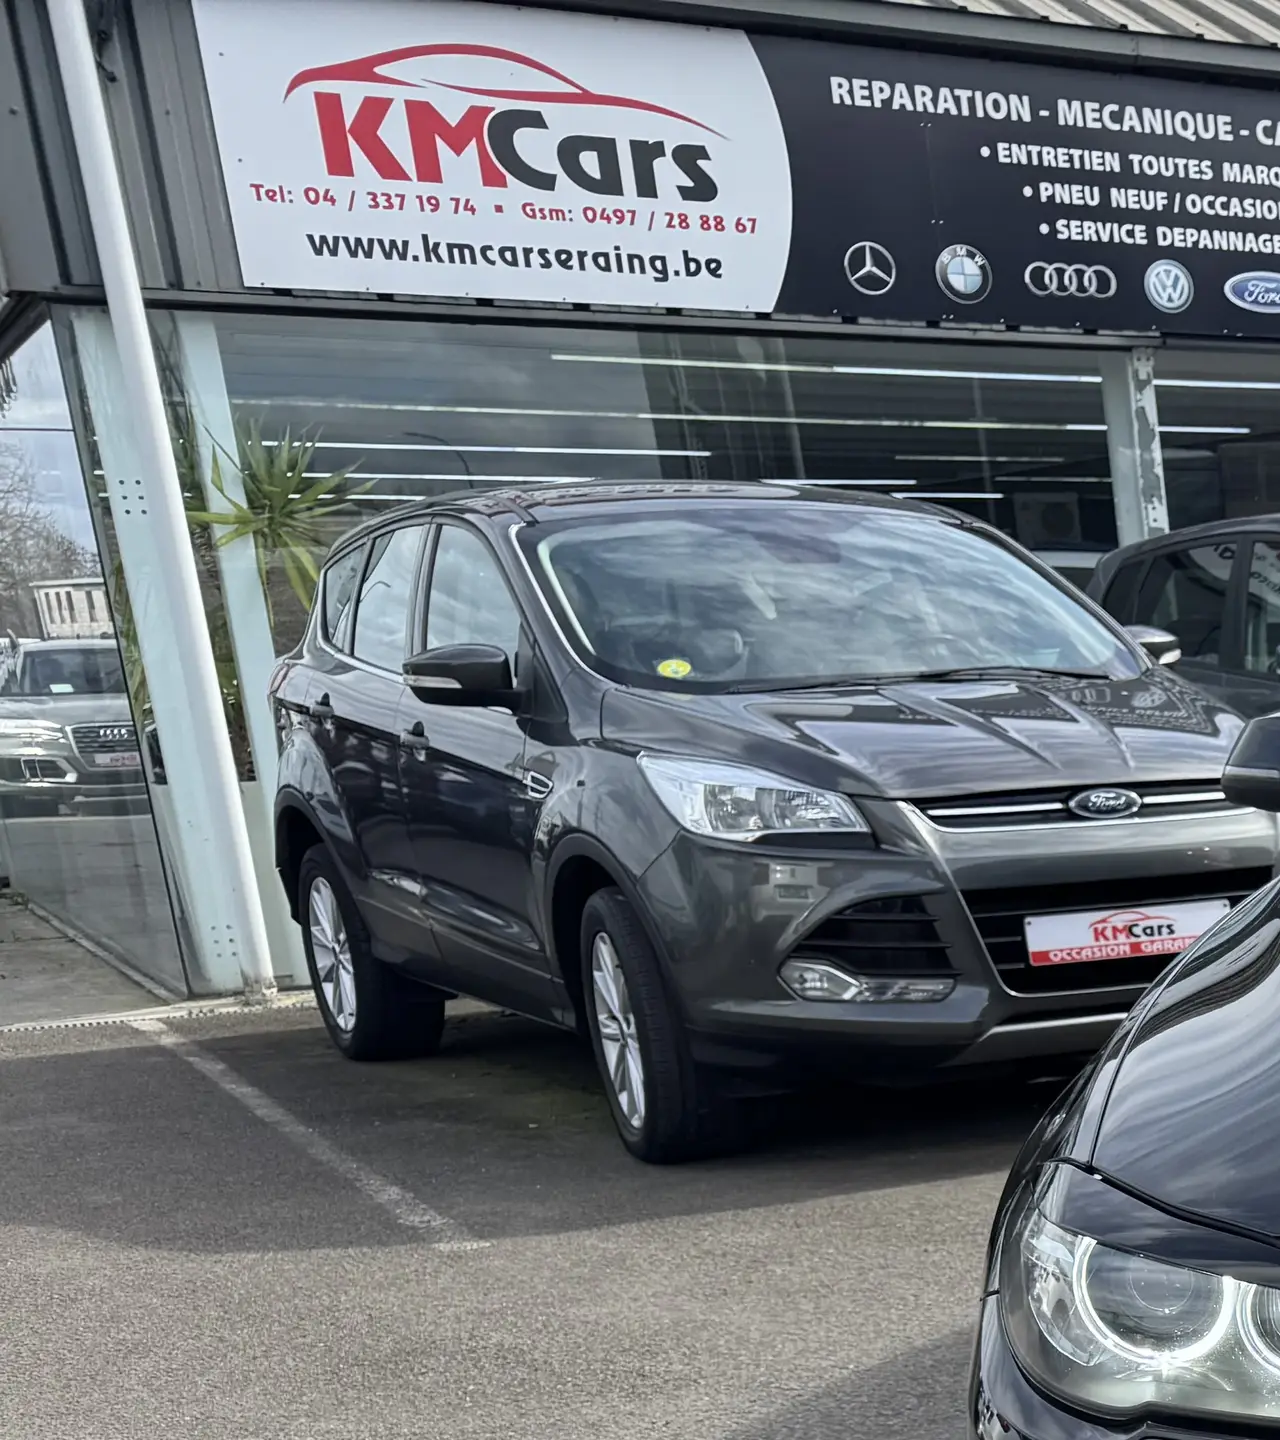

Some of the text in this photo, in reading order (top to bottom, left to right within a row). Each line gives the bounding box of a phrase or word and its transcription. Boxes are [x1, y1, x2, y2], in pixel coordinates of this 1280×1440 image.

[829, 75, 1032, 123] REPARATION
[1056, 98, 1234, 142] MECANIQUE
[313, 91, 719, 203] KMCars
[996, 141, 1121, 173] ENTRETIEN
[1128, 154, 1214, 181] TOUTES
[249, 183, 294, 204] Tel:
[303, 186, 337, 206] 04
[366, 191, 406, 211] 337
[415, 195, 441, 213] 19
[449, 197, 477, 216] 74
[521, 201, 574, 222] Gsm:
[582, 206, 637, 226] 0497
[664, 211, 691, 230] 28
[699, 214, 726, 232] 88
[734, 217, 757, 234] 67
[1038, 181, 1100, 207] PNEU
[1110, 187, 1169, 212] NEUF
[1055, 218, 1148, 245] SERVICE
[305, 233, 723, 283] www.kmcarseraing.be
[1048, 942, 1131, 962] OCCASION
[1093, 922, 1176, 942] KMCars
